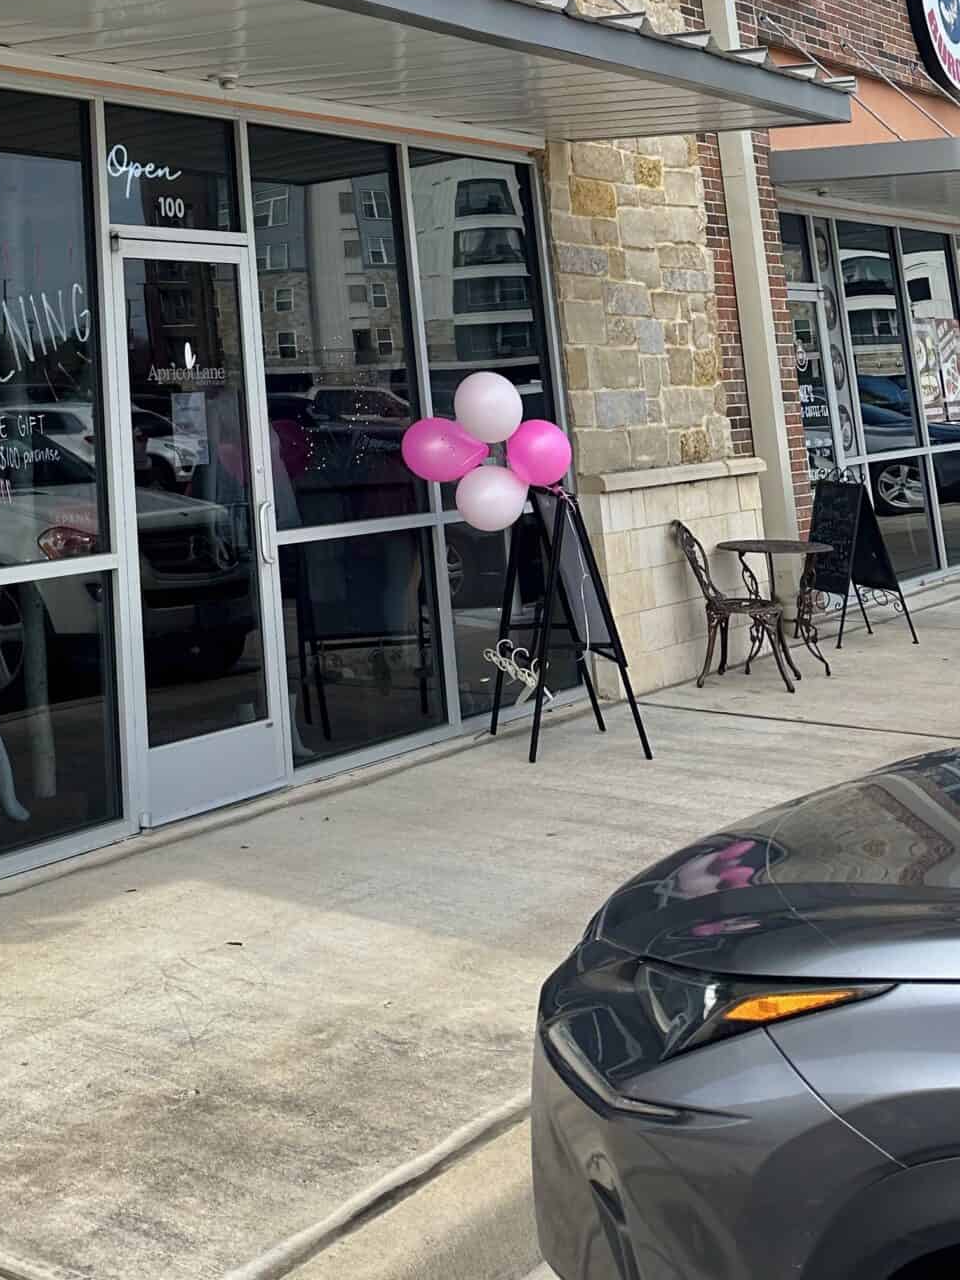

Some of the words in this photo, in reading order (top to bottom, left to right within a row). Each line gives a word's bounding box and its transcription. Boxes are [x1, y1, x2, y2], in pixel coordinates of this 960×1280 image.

[107, 144, 181, 198] Open
[158, 197, 185, 218] 100
[18, 414, 46, 437] GIFT
[0, 446, 20, 470] $100
